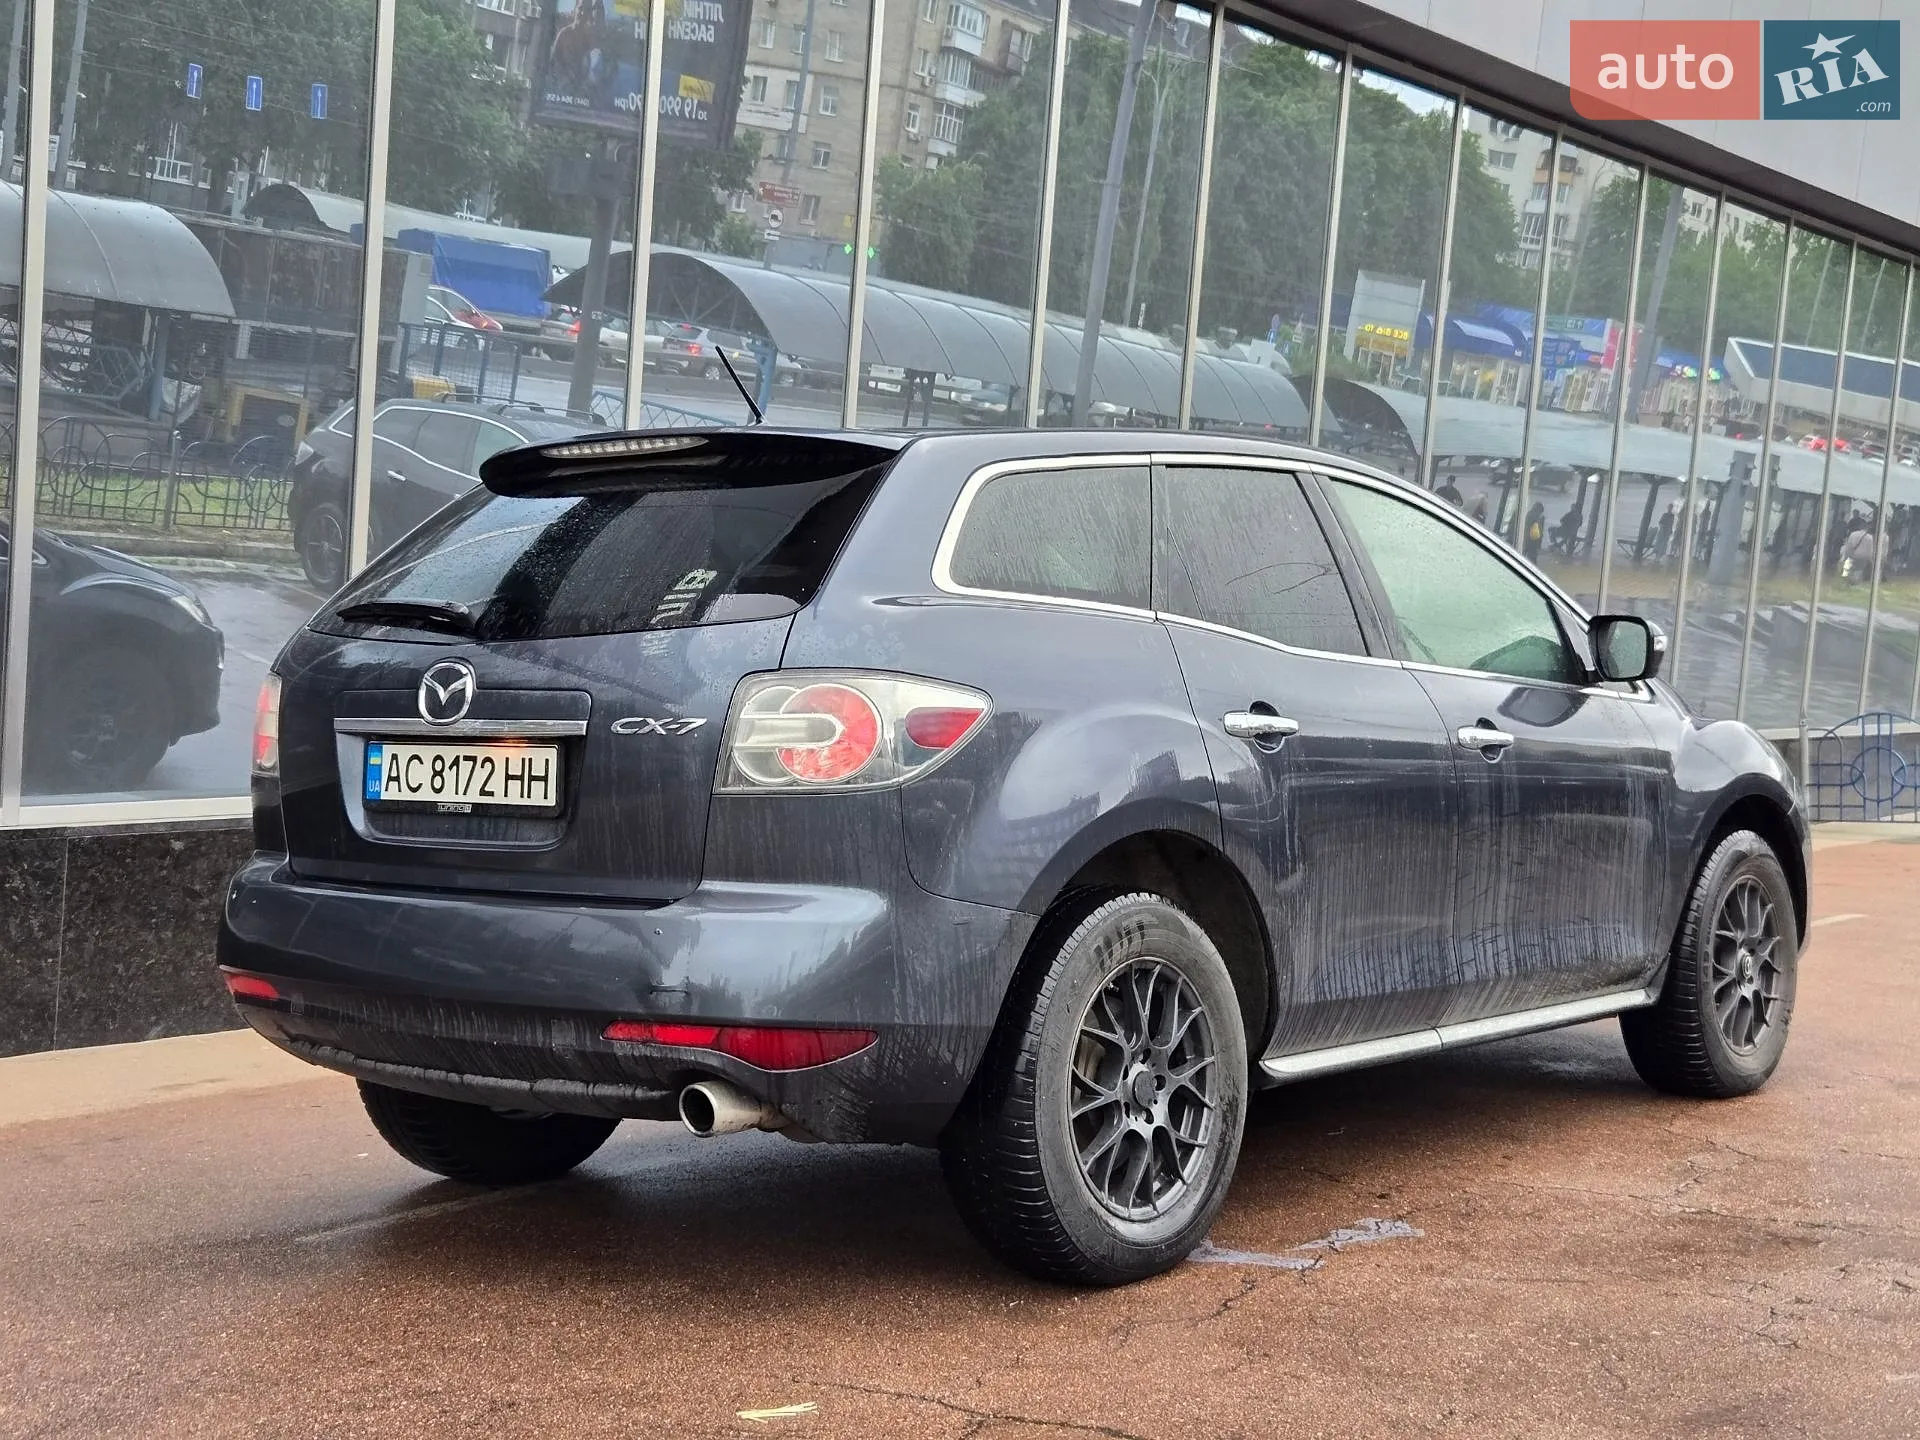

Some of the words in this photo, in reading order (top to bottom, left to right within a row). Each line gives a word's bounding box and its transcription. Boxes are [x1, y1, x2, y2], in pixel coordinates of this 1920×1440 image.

[611, 717, 708, 735] CX-7
[385, 753, 424, 794] AC
[430, 754, 496, 797] 8172
[503, 757, 550, 800] HH
[368, 779, 381, 793] UA
